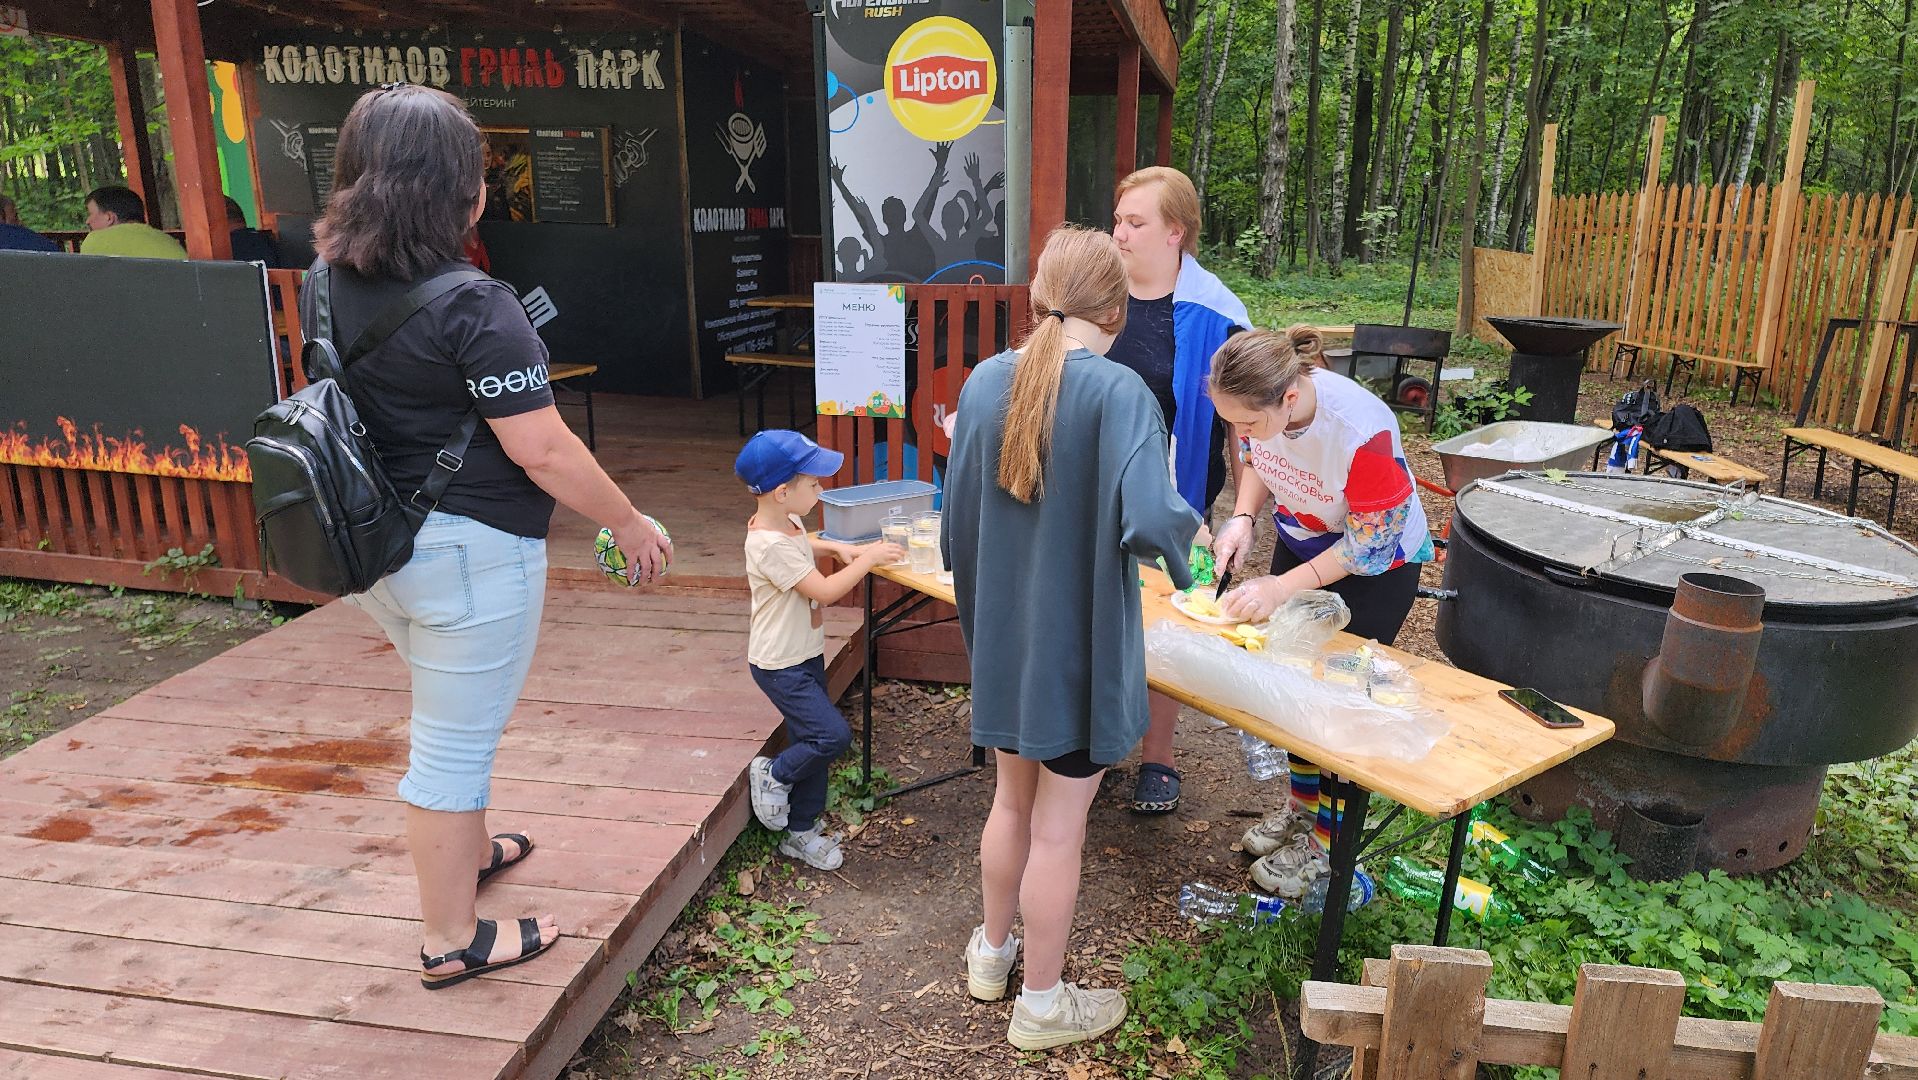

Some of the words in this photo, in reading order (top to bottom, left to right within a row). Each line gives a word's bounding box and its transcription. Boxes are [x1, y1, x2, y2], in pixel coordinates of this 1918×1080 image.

[864, 6, 902, 18] RUSH
[263, 45, 451, 87] КОЛОТИЛОВ
[460, 47, 565, 88] ГРИЛЬ
[575, 49, 665, 90] ПАРК
[900, 67, 980, 96] Lipton
[693, 207, 745, 232] КОЛОТИЛОВ
[842, 303, 876, 312] МЕНЮ
[1252, 456, 1334, 503] ОДМОСКОВЬЯ
[1255, 443, 1324, 489] ВОЛОНТЕРЫ
[1278, 485, 1307, 504] РЯДОМ
